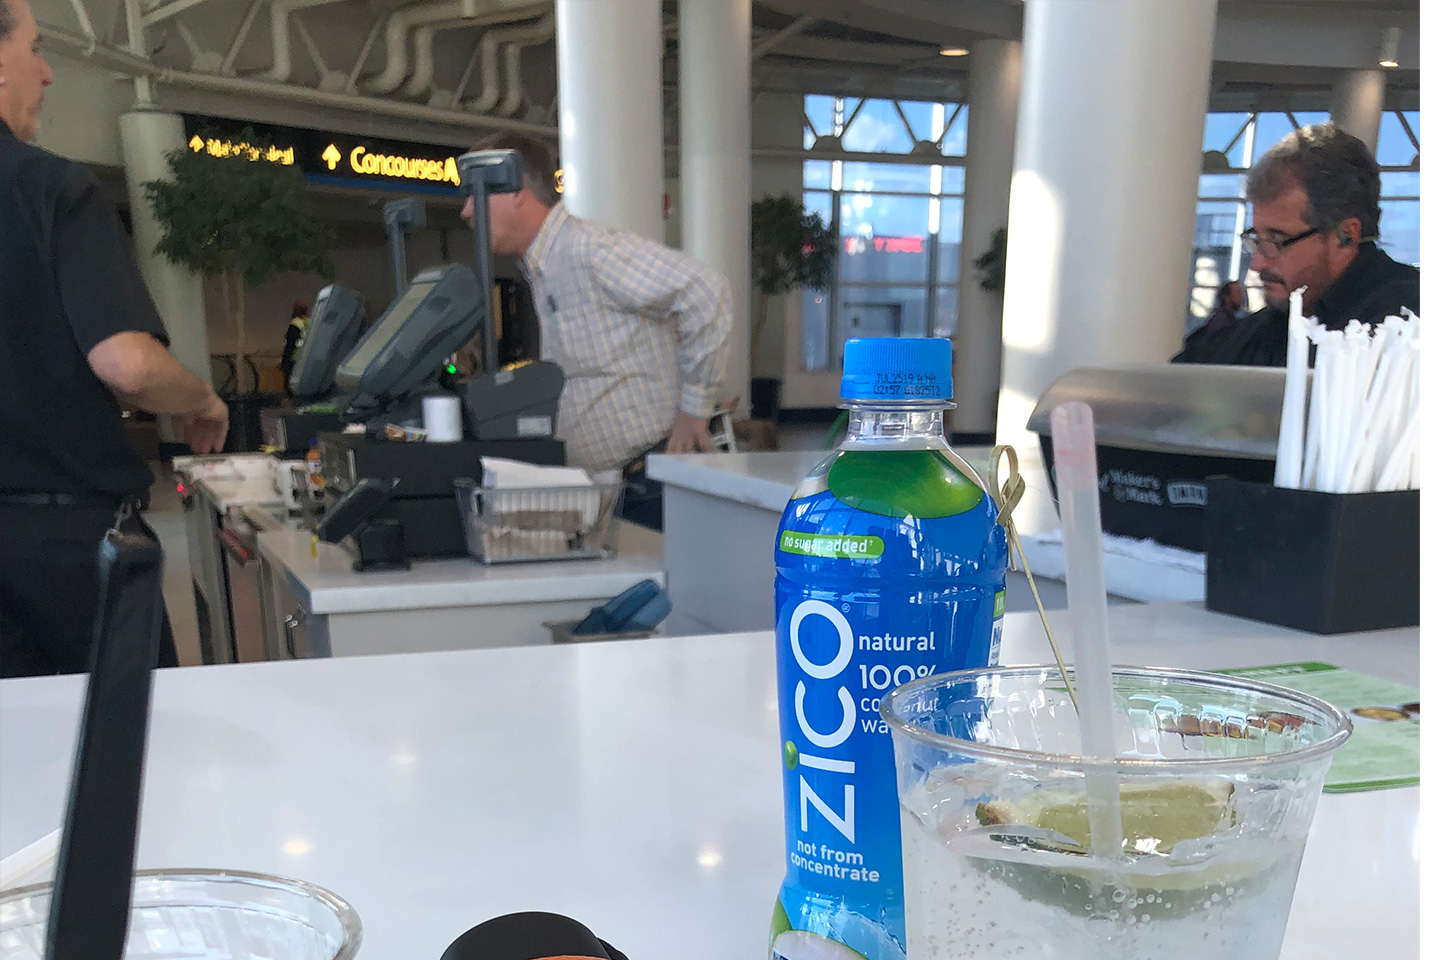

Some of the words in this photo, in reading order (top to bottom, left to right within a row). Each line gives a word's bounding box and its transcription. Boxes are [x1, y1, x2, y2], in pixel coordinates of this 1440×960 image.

[350, 146, 443, 181] Concourses
[784, 536, 794, 547] no
[794, 537, 824, 552] sugar
[859, 631, 936, 652] natural
[790, 600, 857, 844] ZICO
[791, 852, 880, 882] concentrate
[797, 840, 817, 858] not
[820, 845, 864, 866] from
